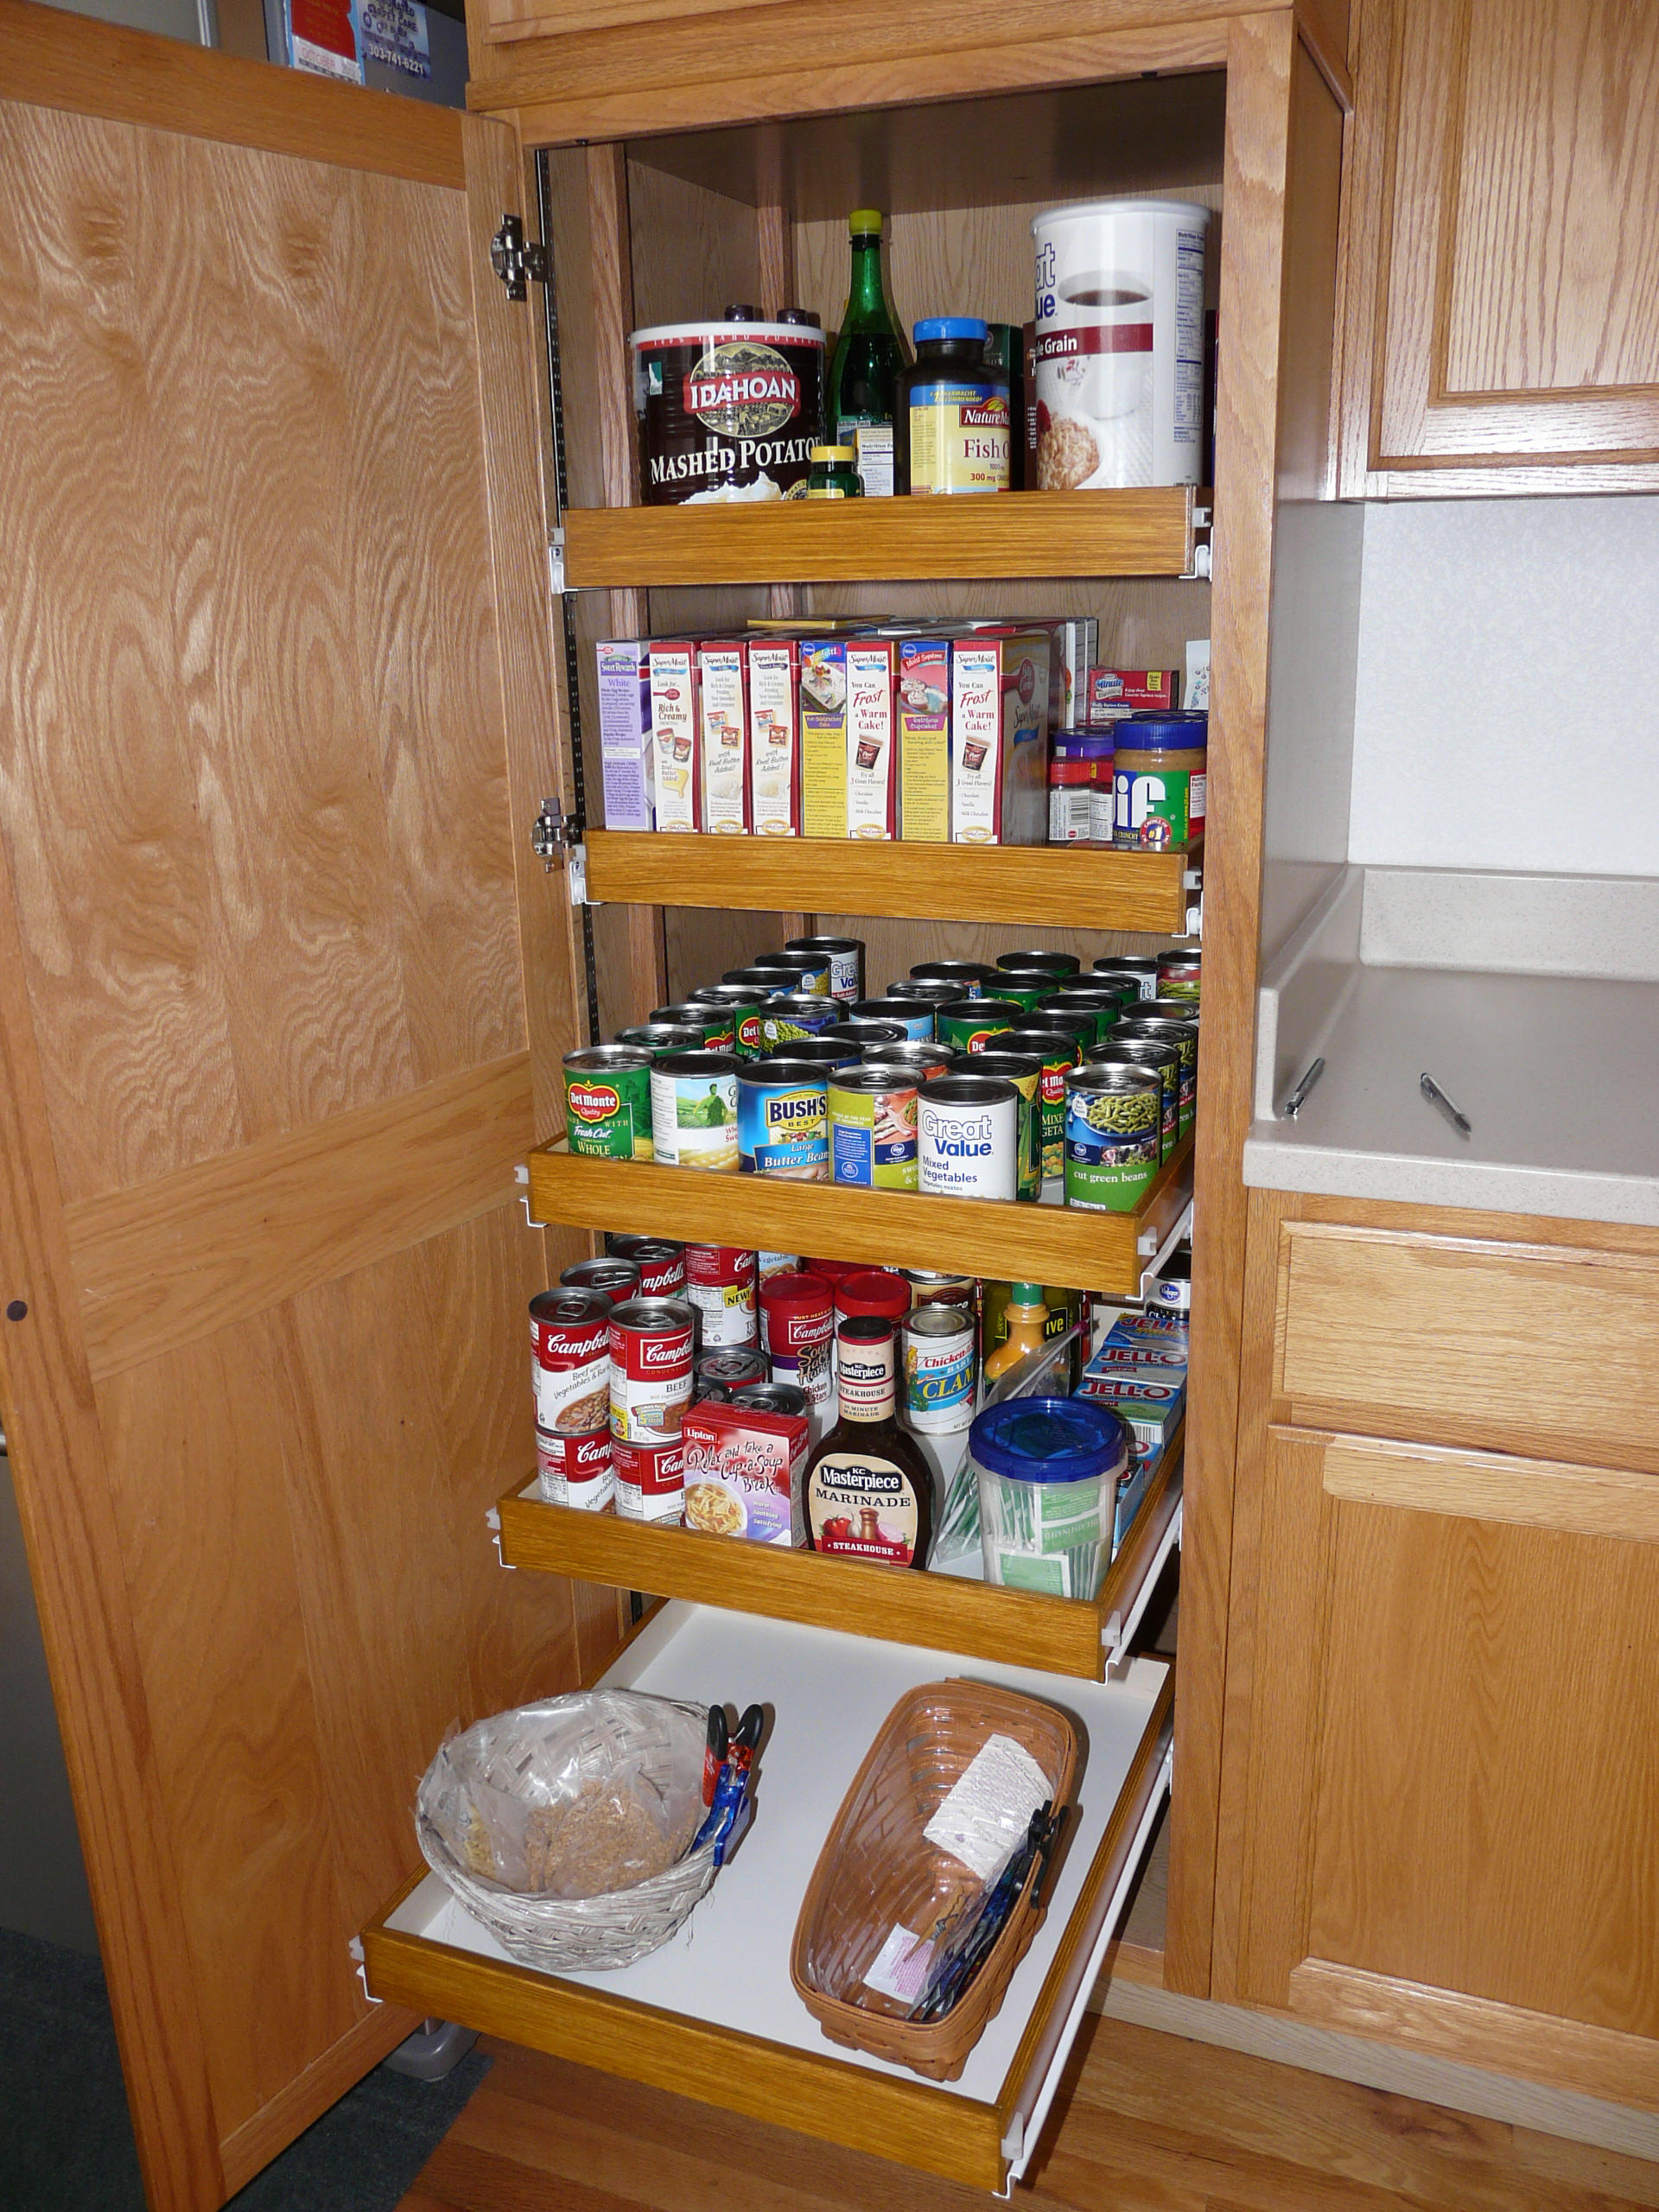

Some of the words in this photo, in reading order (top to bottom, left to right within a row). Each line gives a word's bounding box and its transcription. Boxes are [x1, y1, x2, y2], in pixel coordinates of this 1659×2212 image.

[368, 42, 425, 75] 303-741-6221
[1045, 334, 1078, 355] Grain
[690, 378, 797, 410] IDAHOAN
[963, 439, 1001, 458] Fish
[650, 448, 736, 484] MASHED
[970, 473, 985, 481] 300
[608, 677, 630, 687] White
[658, 679, 668, 688] Look
[1096, 678, 1123, 690] Minute
[853, 689, 885, 708] Frost
[960, 689, 994, 709] Frost
[658, 703, 675, 714] Rich
[861, 709, 887, 718] Warm
[968, 709, 995, 720] Warm
[658, 712, 688, 723] Creamy
[859, 720, 884, 730] Cake!
[965, 721, 991, 731] Cake!
[1148, 826, 1163, 841] #1
[743, 1026, 757, 1038] Del
[971, 1039, 985, 1052] De
[570, 1092, 583, 1105] Del
[583, 1094, 616, 1108] Monte
[581, 1108, 601, 1118] Quality
[769, 1094, 826, 1123] BUSH'S
[788, 1118, 816, 1128] BEST
[922, 1109, 993, 1141] Great
[1043, 1112, 1065, 1127] MIXE
[577, 1140, 611, 1155] WHOLE
[791, 1142, 814, 1153] Large
[935, 1138, 993, 1157] Value
[765, 1156, 803, 1168] Butter
[923, 1154, 949, 1172] Mixed
[923, 1169, 978, 1183] Vegetables
[1074, 1170, 1087, 1180] cut
[1090, 1173, 1117, 1184] green
[1121, 1171, 1147, 1183] beans
[727, 1289, 751, 1306] NEW!
[1046, 1318, 1064, 1335] ive
[797, 1344, 830, 1363] Soup
[925, 1350, 966, 1369] Chicken
[1101, 1349, 1186, 1364] JELL-O
[572, 1367, 589, 1381] Beef
[839, 1364, 885, 1380] Masterpiece
[553, 1375, 592, 1401] Vegetables
[666, 1379, 689, 1393] BEEF
[803, 1382, 828, 1395] Chicken
[923, 1366, 975, 1399] CLAM
[810, 1391, 827, 1402] Stars
[839, 1386, 886, 1398] STEAKHOUSE
[1080, 1382, 1172, 1399] JELL-O
[686, 1428, 715, 1442] Lipton
[686, 1445, 721, 1475] Relax
[725, 1445, 740, 1459] and
[766, 1444, 774, 1453] a
[823, 1466, 899, 1490] Masterpiece
[816, 1487, 911, 1508] MARINADE
[833, 1541, 894, 1556] STEAKHOUSE
